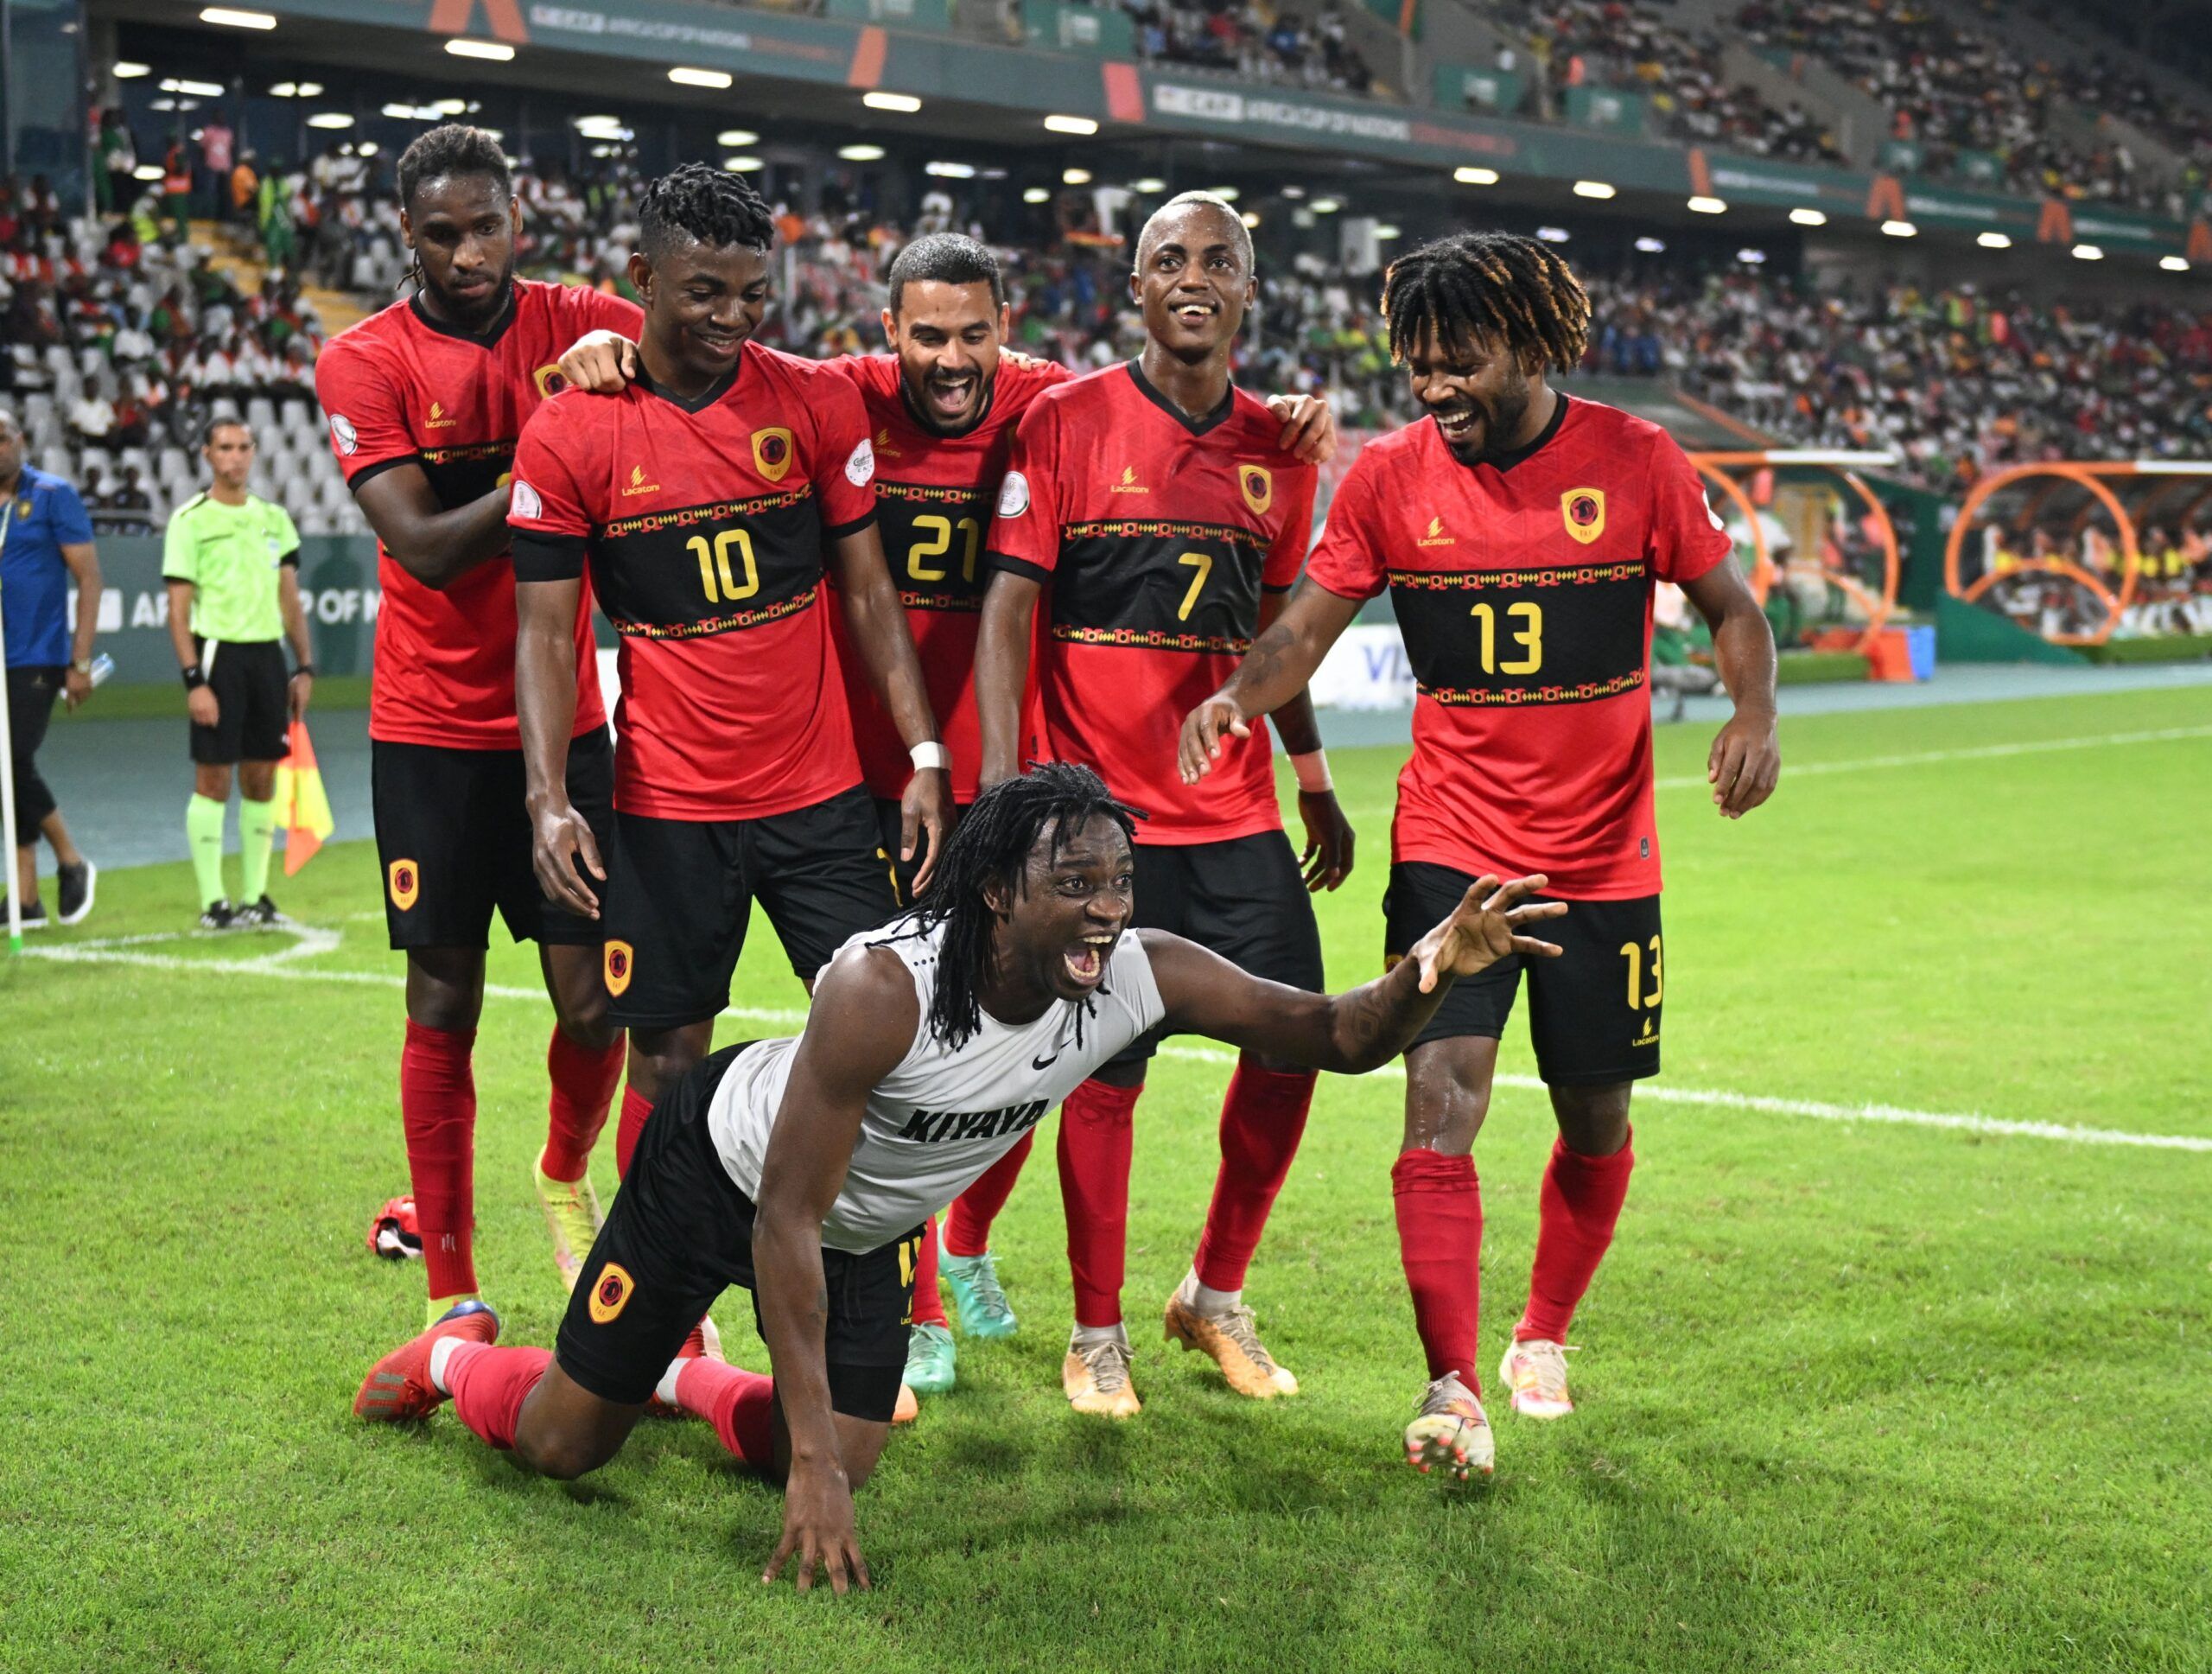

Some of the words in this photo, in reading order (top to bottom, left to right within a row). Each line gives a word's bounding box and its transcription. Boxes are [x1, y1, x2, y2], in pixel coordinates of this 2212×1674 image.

[622, 484, 660, 496] Lacatoni
[1110, 485, 1149, 493] Lacatoni
[686, 528, 760, 603] 10
[906, 514, 979, 583] 21
[1417, 538, 1455, 546] Lacatoni
[316, 589, 360, 624] OF
[1178, 552, 1213, 621] 7
[1470, 601, 1542, 675] 13
[1620, 934, 1662, 1010] 13
[897, 1098, 1050, 1143] KIYAYA
